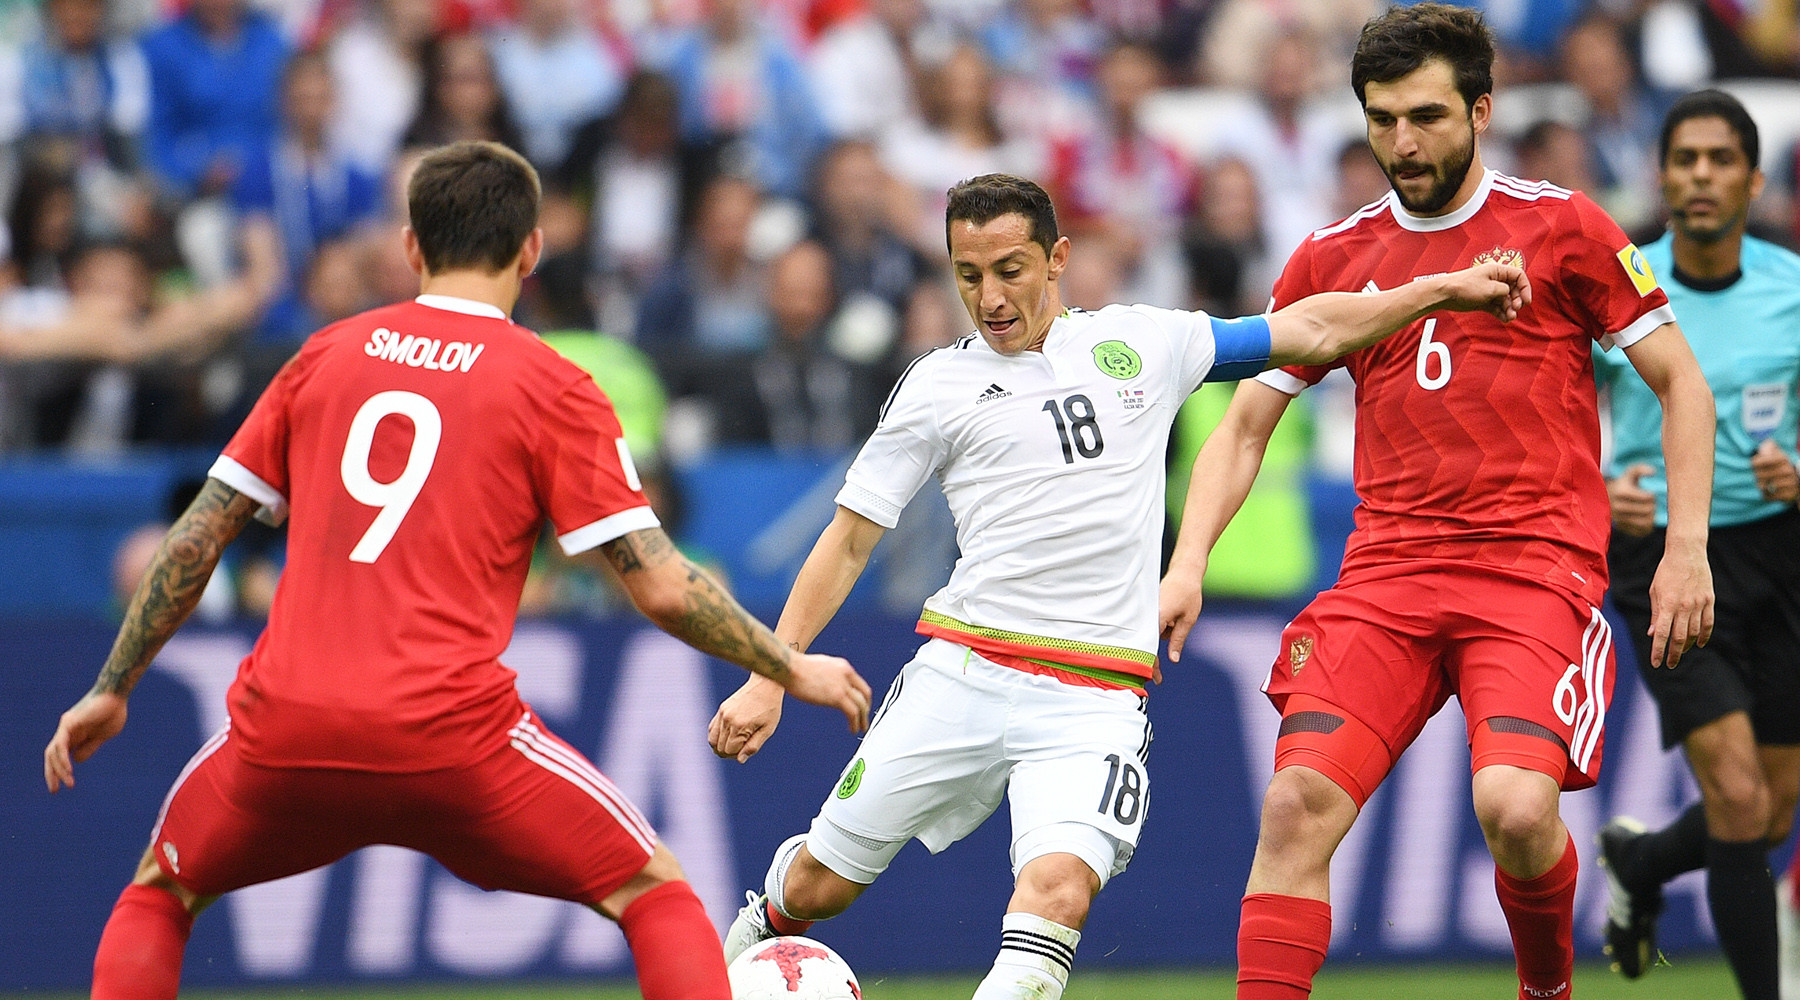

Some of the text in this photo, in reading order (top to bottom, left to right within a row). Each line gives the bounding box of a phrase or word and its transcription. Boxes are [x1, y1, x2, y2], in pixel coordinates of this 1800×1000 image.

[364, 327, 485, 373] SMOLOV
[1416, 317, 1452, 391] 6
[975, 391, 1013, 405] adidas
[1042, 394, 1104, 464] 18
[340, 390, 442, 564] 9
[1552, 663, 1581, 727] 6
[1098, 753, 1141, 826] 18
